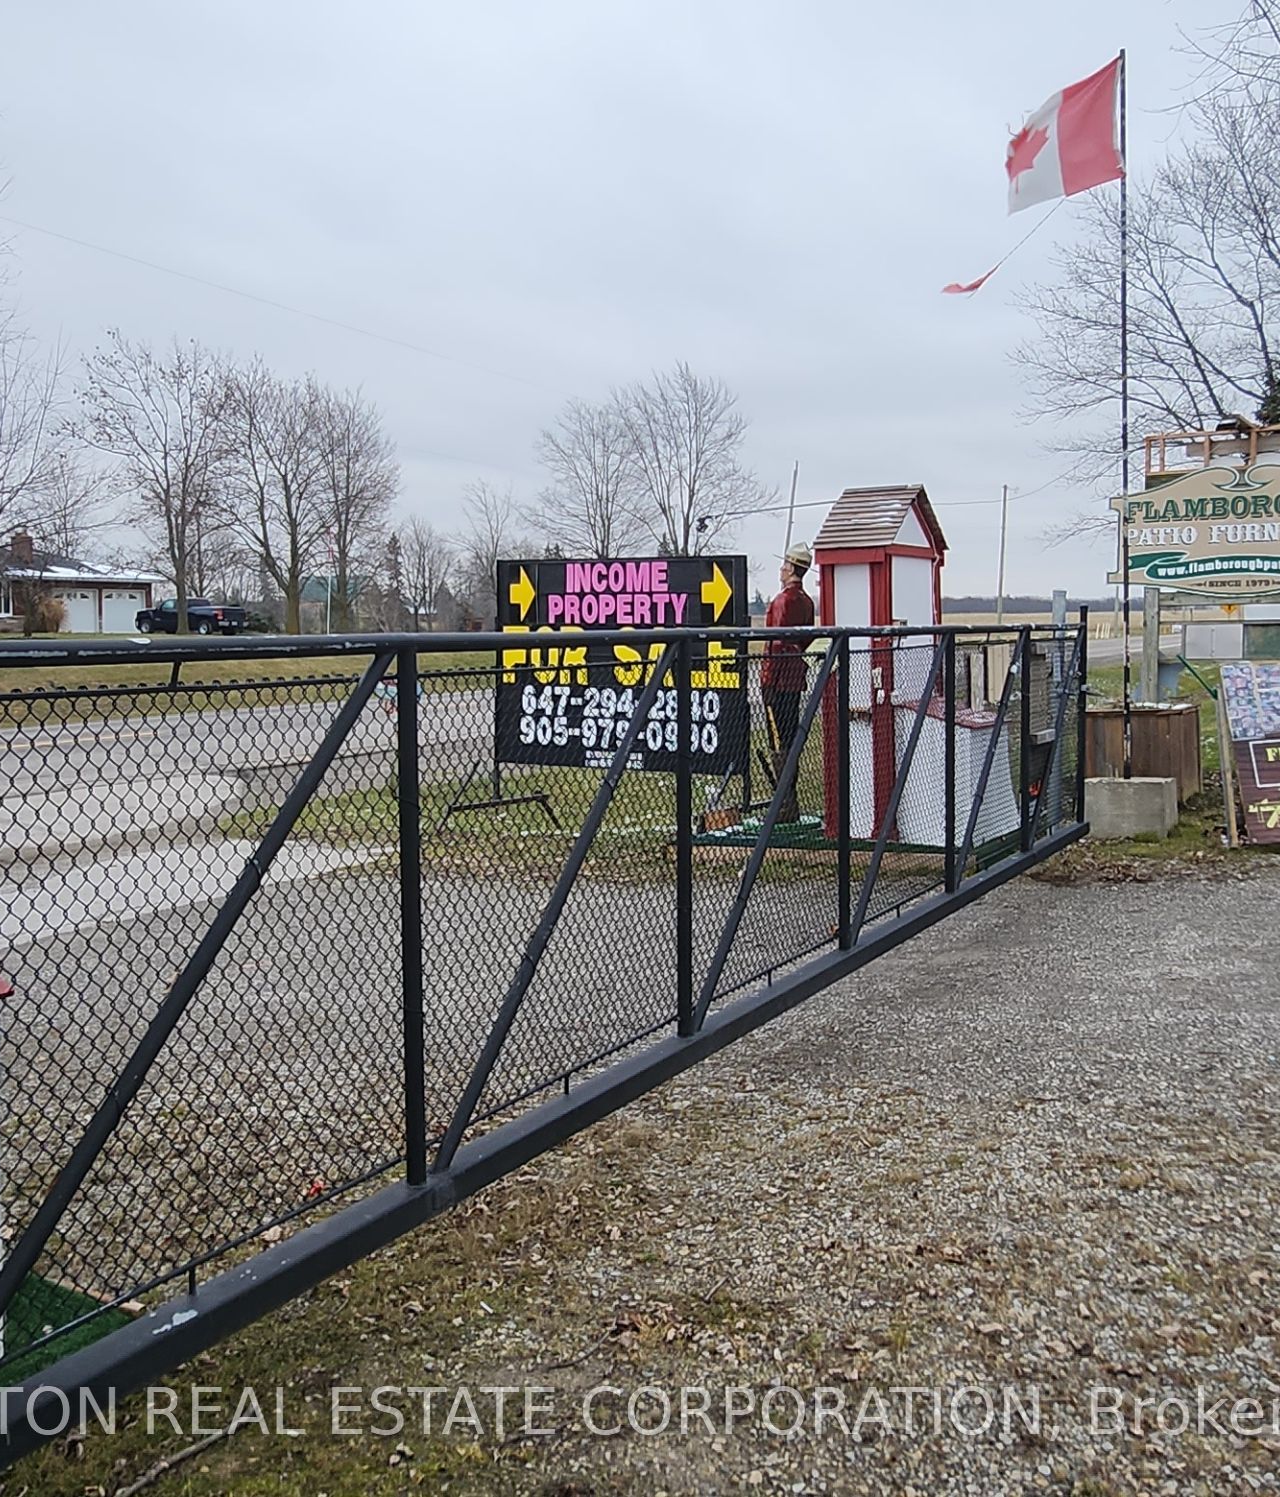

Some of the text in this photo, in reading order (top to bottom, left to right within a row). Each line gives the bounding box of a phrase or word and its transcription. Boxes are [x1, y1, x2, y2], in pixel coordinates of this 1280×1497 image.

[1127, 525, 1198, 548] PATIO
[566, 561, 669, 593] INCOME
[548, 593, 688, 625] PROPERTY
[502, 626, 588, 685] FOR
